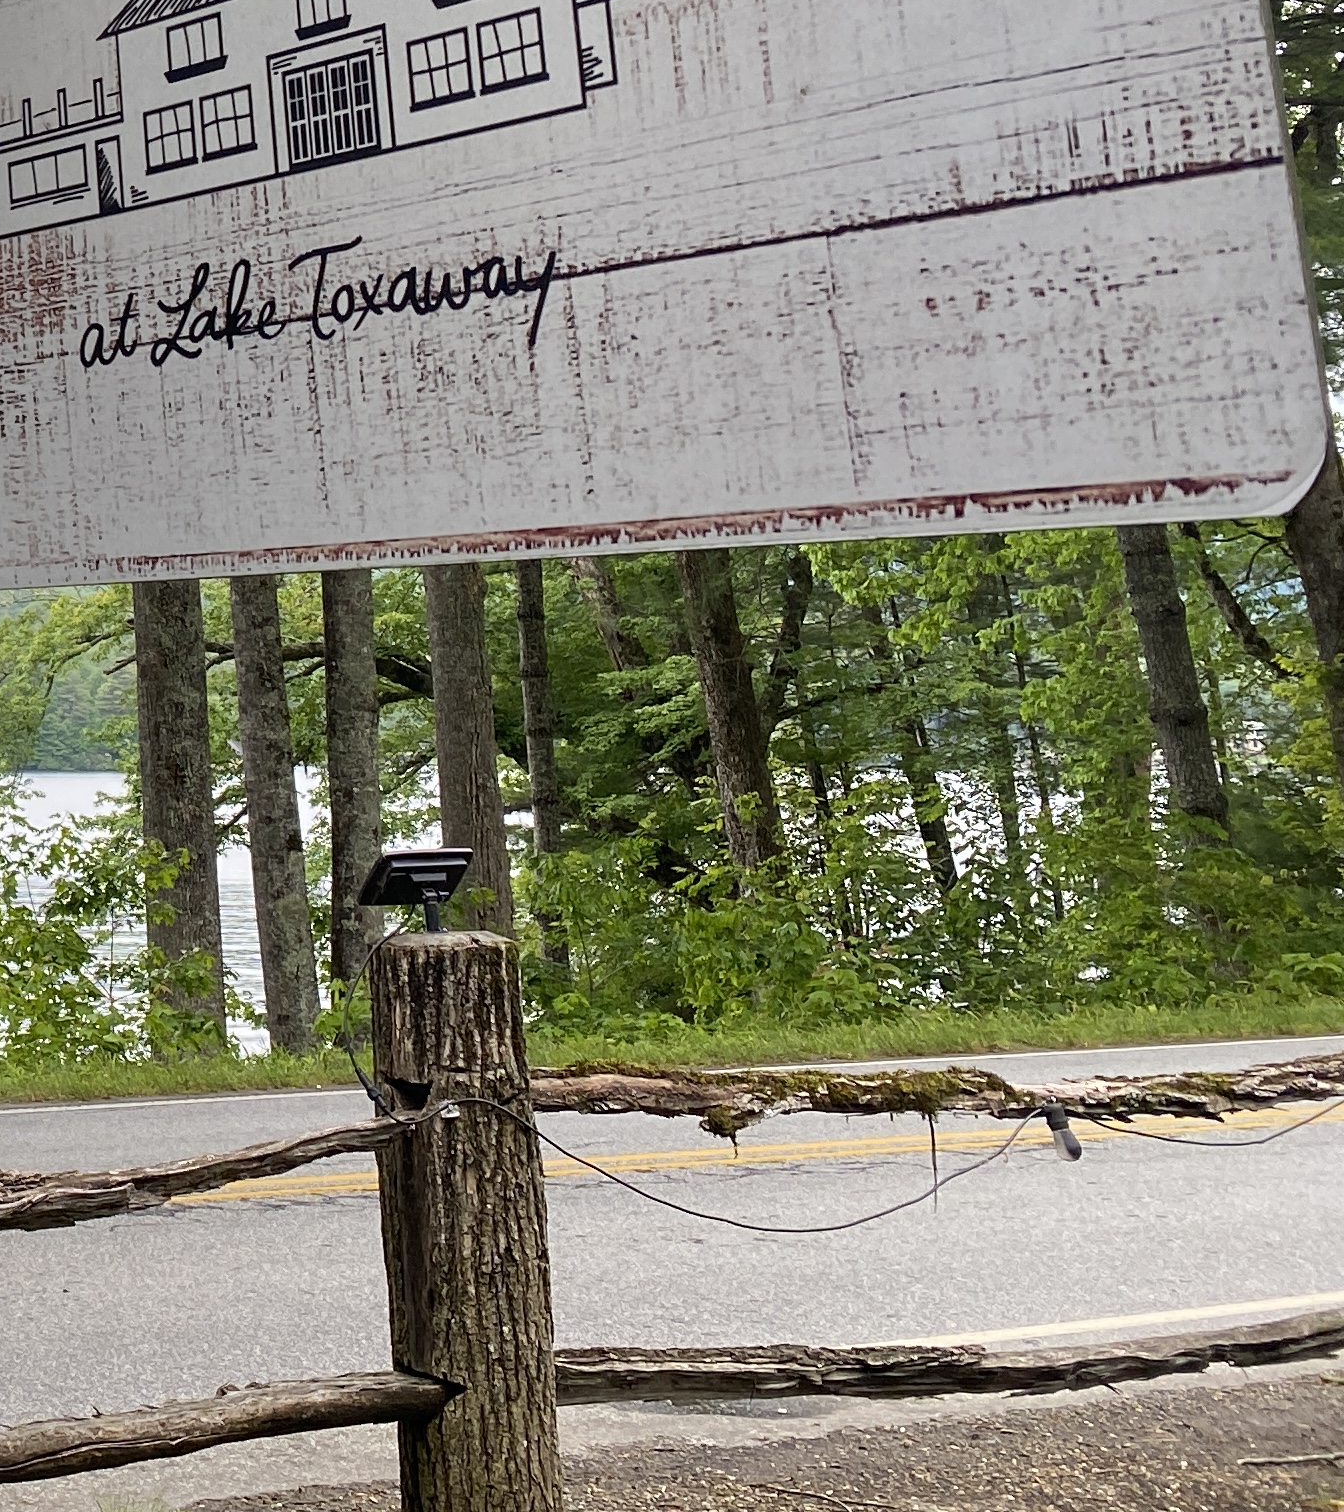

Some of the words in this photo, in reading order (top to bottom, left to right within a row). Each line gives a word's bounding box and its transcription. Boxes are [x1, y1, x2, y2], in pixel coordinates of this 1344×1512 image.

[79, 292, 139, 368] at
[150, 260, 286, 367] Lake
[288, 236, 557, 347] Toxaway
